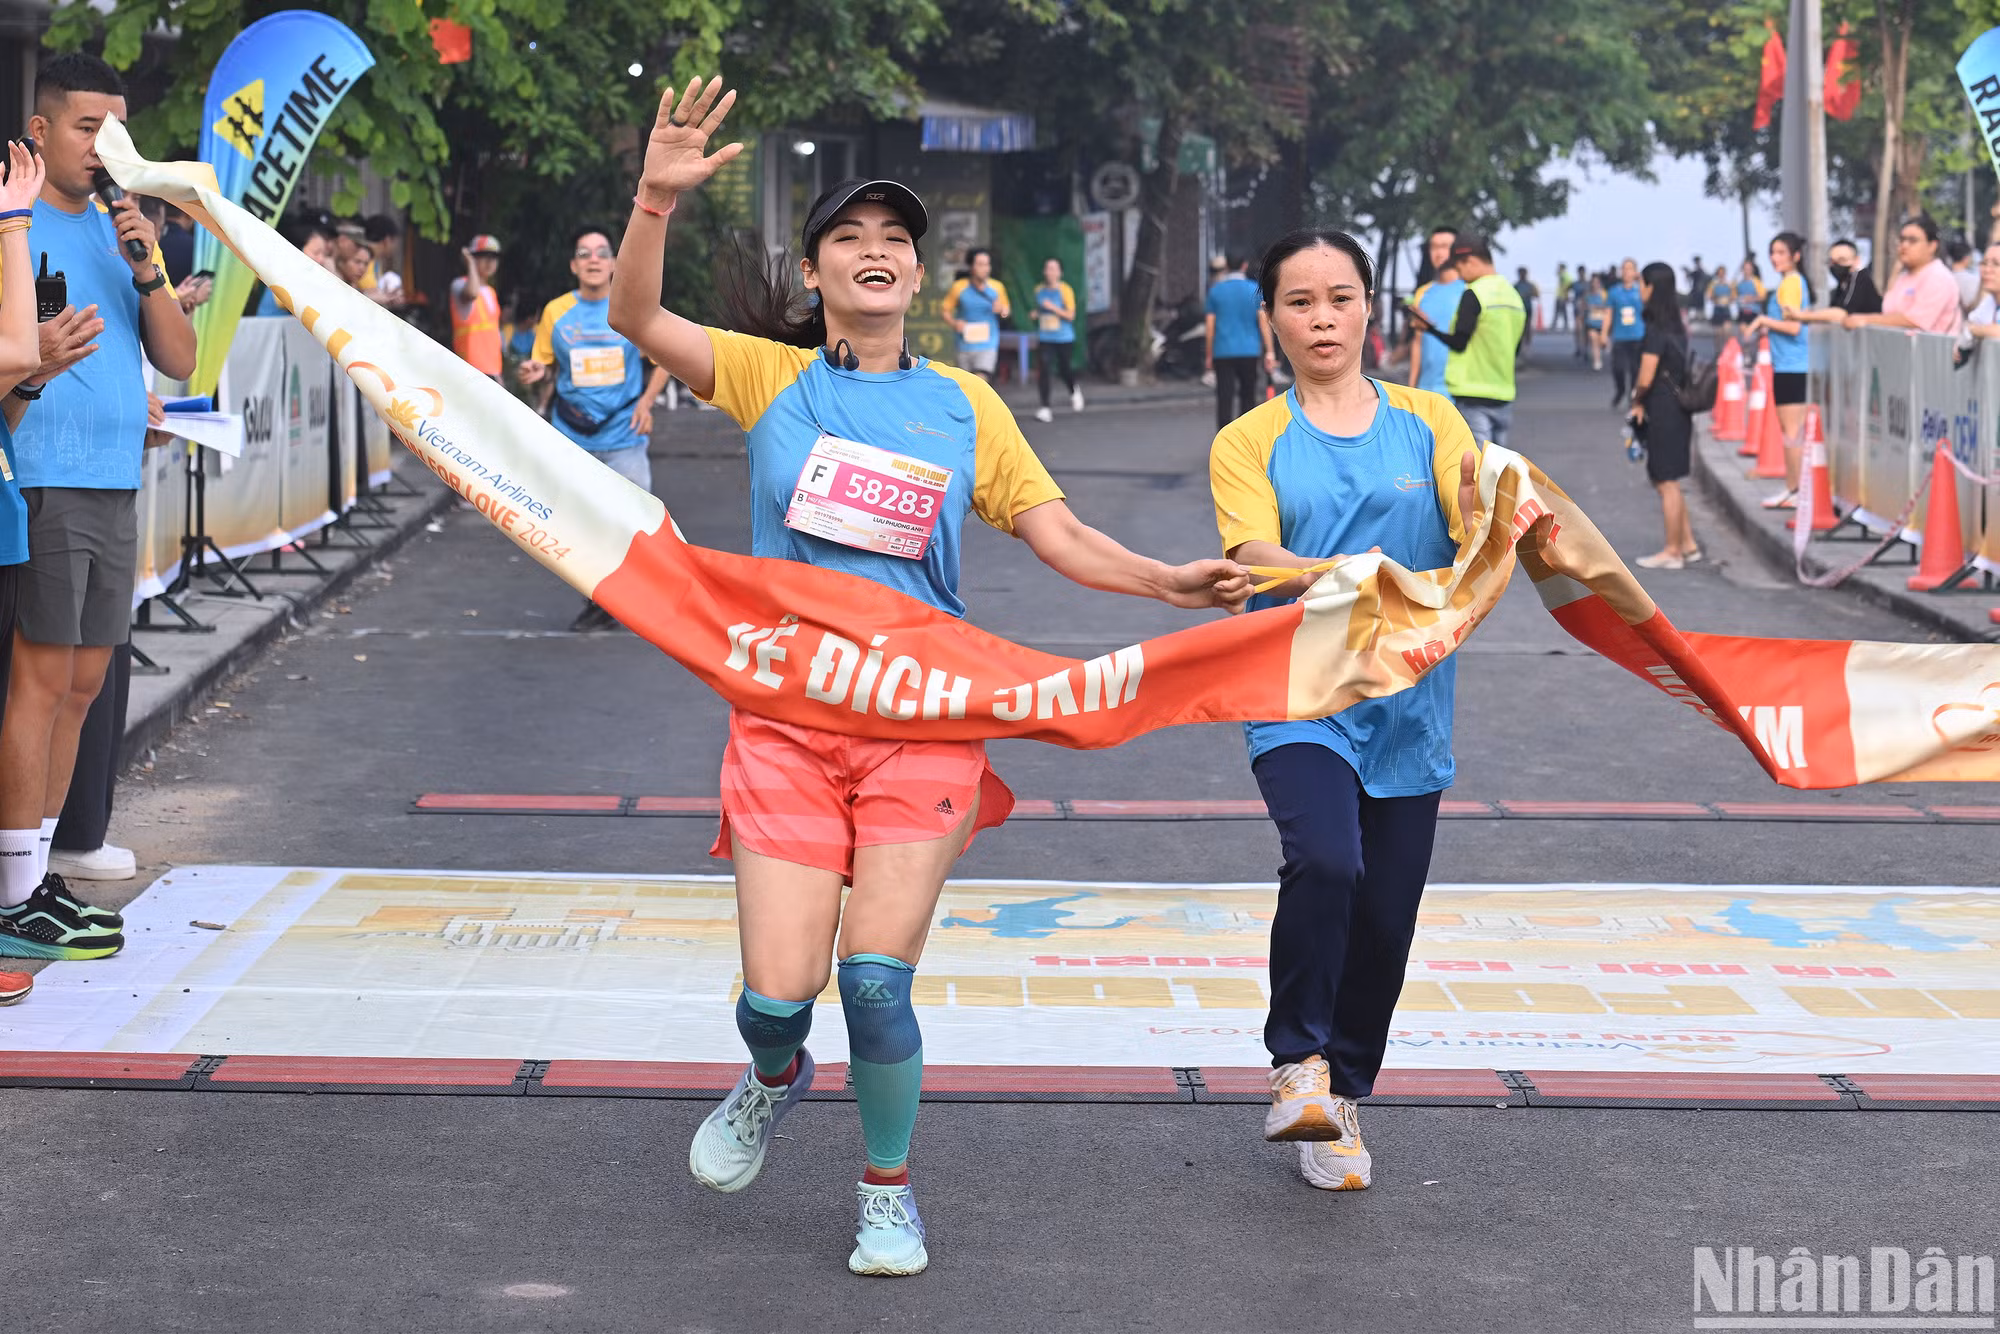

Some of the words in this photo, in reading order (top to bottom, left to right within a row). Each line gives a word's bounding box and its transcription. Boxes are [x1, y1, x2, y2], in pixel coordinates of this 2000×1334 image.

[242, 53, 350, 223] ACETIME
[418, 419, 489, 479] Vietnam
[484, 473, 553, 522] Airlines
[797, 493, 804, 502] B
[810, 464, 828, 483] F
[844, 472, 935, 519] 58283
[466, 483, 521, 532] LOVE
[518, 523, 571, 561] 2024
[805, 632, 973, 722] ĐÍCH
[991, 643, 1146, 722] 5KM
[934, 806, 955, 816] adidas
